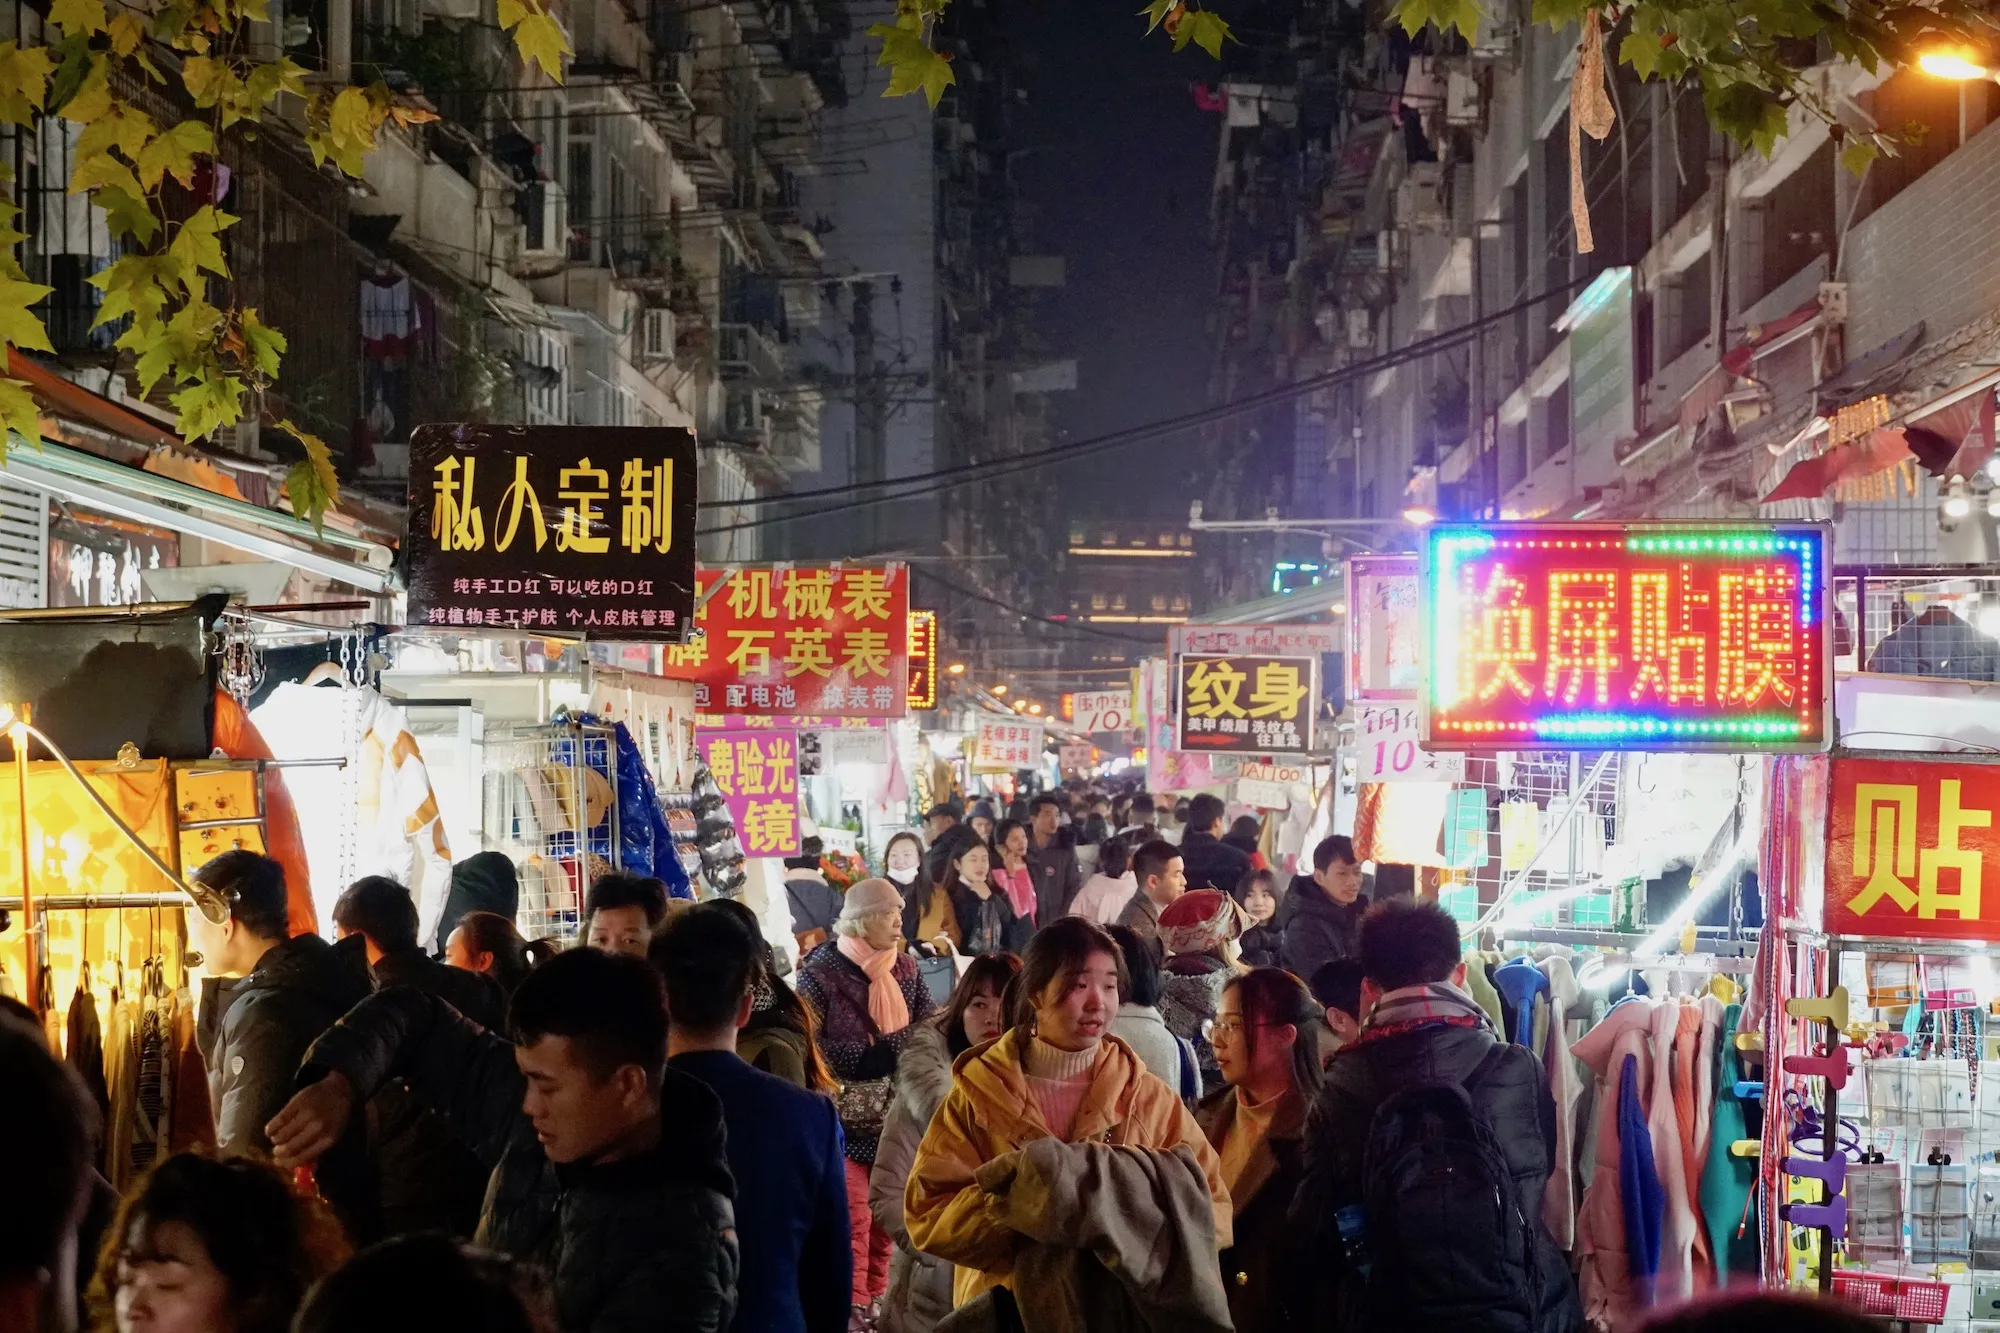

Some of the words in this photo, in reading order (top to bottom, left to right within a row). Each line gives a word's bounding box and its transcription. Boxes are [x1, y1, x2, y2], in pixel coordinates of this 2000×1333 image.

[432, 454, 673, 554] 私人定制
[428, 607, 558, 626] 纯植物手工护肤
[566, 608, 676, 627] 个人皮肤管理
[727, 569, 892, 621] 机械表
[1466, 563, 1796, 707] 换屏贴膜
[725, 683, 797, 709] 配电池
[822, 684, 894, 709] 换表带
[1186, 661, 1308, 719] 纹身
[1187, 717, 1217, 732] 美甲
[1219, 718, 1249, 734] 绣眉
[1252, 719, 1297, 735] 洗纹身
[1256, 733, 1302, 748] 往里走
[1239, 761, 1300, 782] TATTOO
[743, 799, 796, 853] 镜
[1845, 779, 1993, 921] 贴
